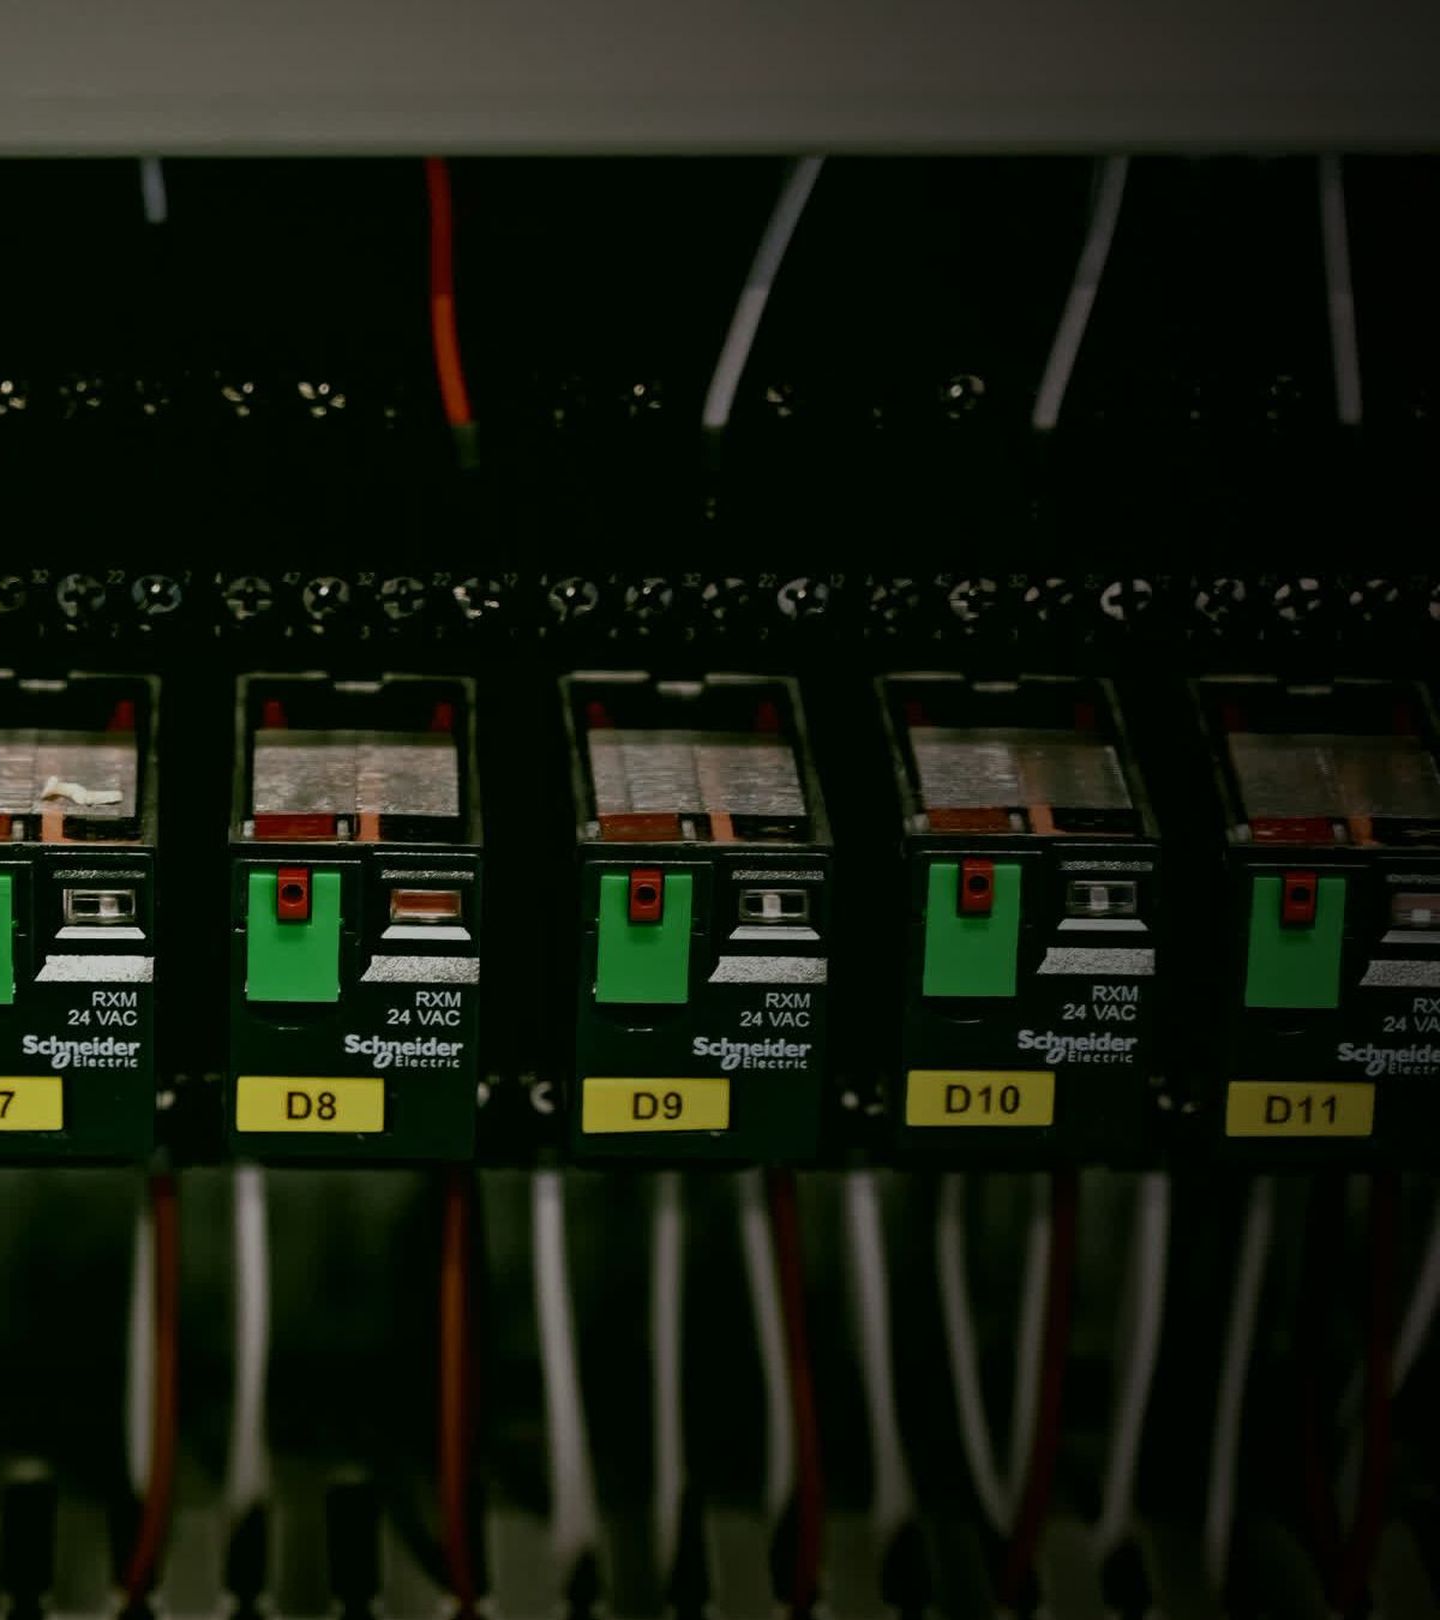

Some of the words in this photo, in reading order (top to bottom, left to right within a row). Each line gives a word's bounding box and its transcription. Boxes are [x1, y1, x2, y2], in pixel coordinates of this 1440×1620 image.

[92, 990, 137, 1008] RXM
[415, 989, 462, 1008] RXM
[765, 992, 811, 1009] RXM
[1092, 984, 1139, 1002] RXM
[1062, 1002, 1087, 1021] 24
[1092, 1002, 1137, 1021] VAC
[1412, 997, 1440, 1014] RX
[67, 1009, 91, 1027] 24
[95, 1009, 138, 1027] VAC
[386, 1008, 412, 1027] 24
[416, 1008, 461, 1027] VAC
[739, 1010, 764, 1028] 24
[768, 1010, 810, 1028] VAC
[1382, 1015, 1407, 1033] 24
[1413, 1015, 1440, 1033] VA
[22, 1034, 141, 1070] Schneider
[344, 1033, 464, 1069] Schneider
[692, 1036, 812, 1071] Schneider
[1017, 1029, 1139, 1065] Schneider
[72, 1055, 139, 1069] Electric
[394, 1055, 461, 1068] Electric
[742, 1056, 808, 1070] Electric
[1067, 1051, 1134, 1064] Electric
[1337, 1042, 1440, 1077] Schneide
[1387, 1062, 1440, 1076] Electr
[286, 1091, 337, 1121] D8
[632, 1091, 683, 1121] D9
[944, 1084, 1021, 1115] D10
[1264, 1094, 1337, 1125] D11
